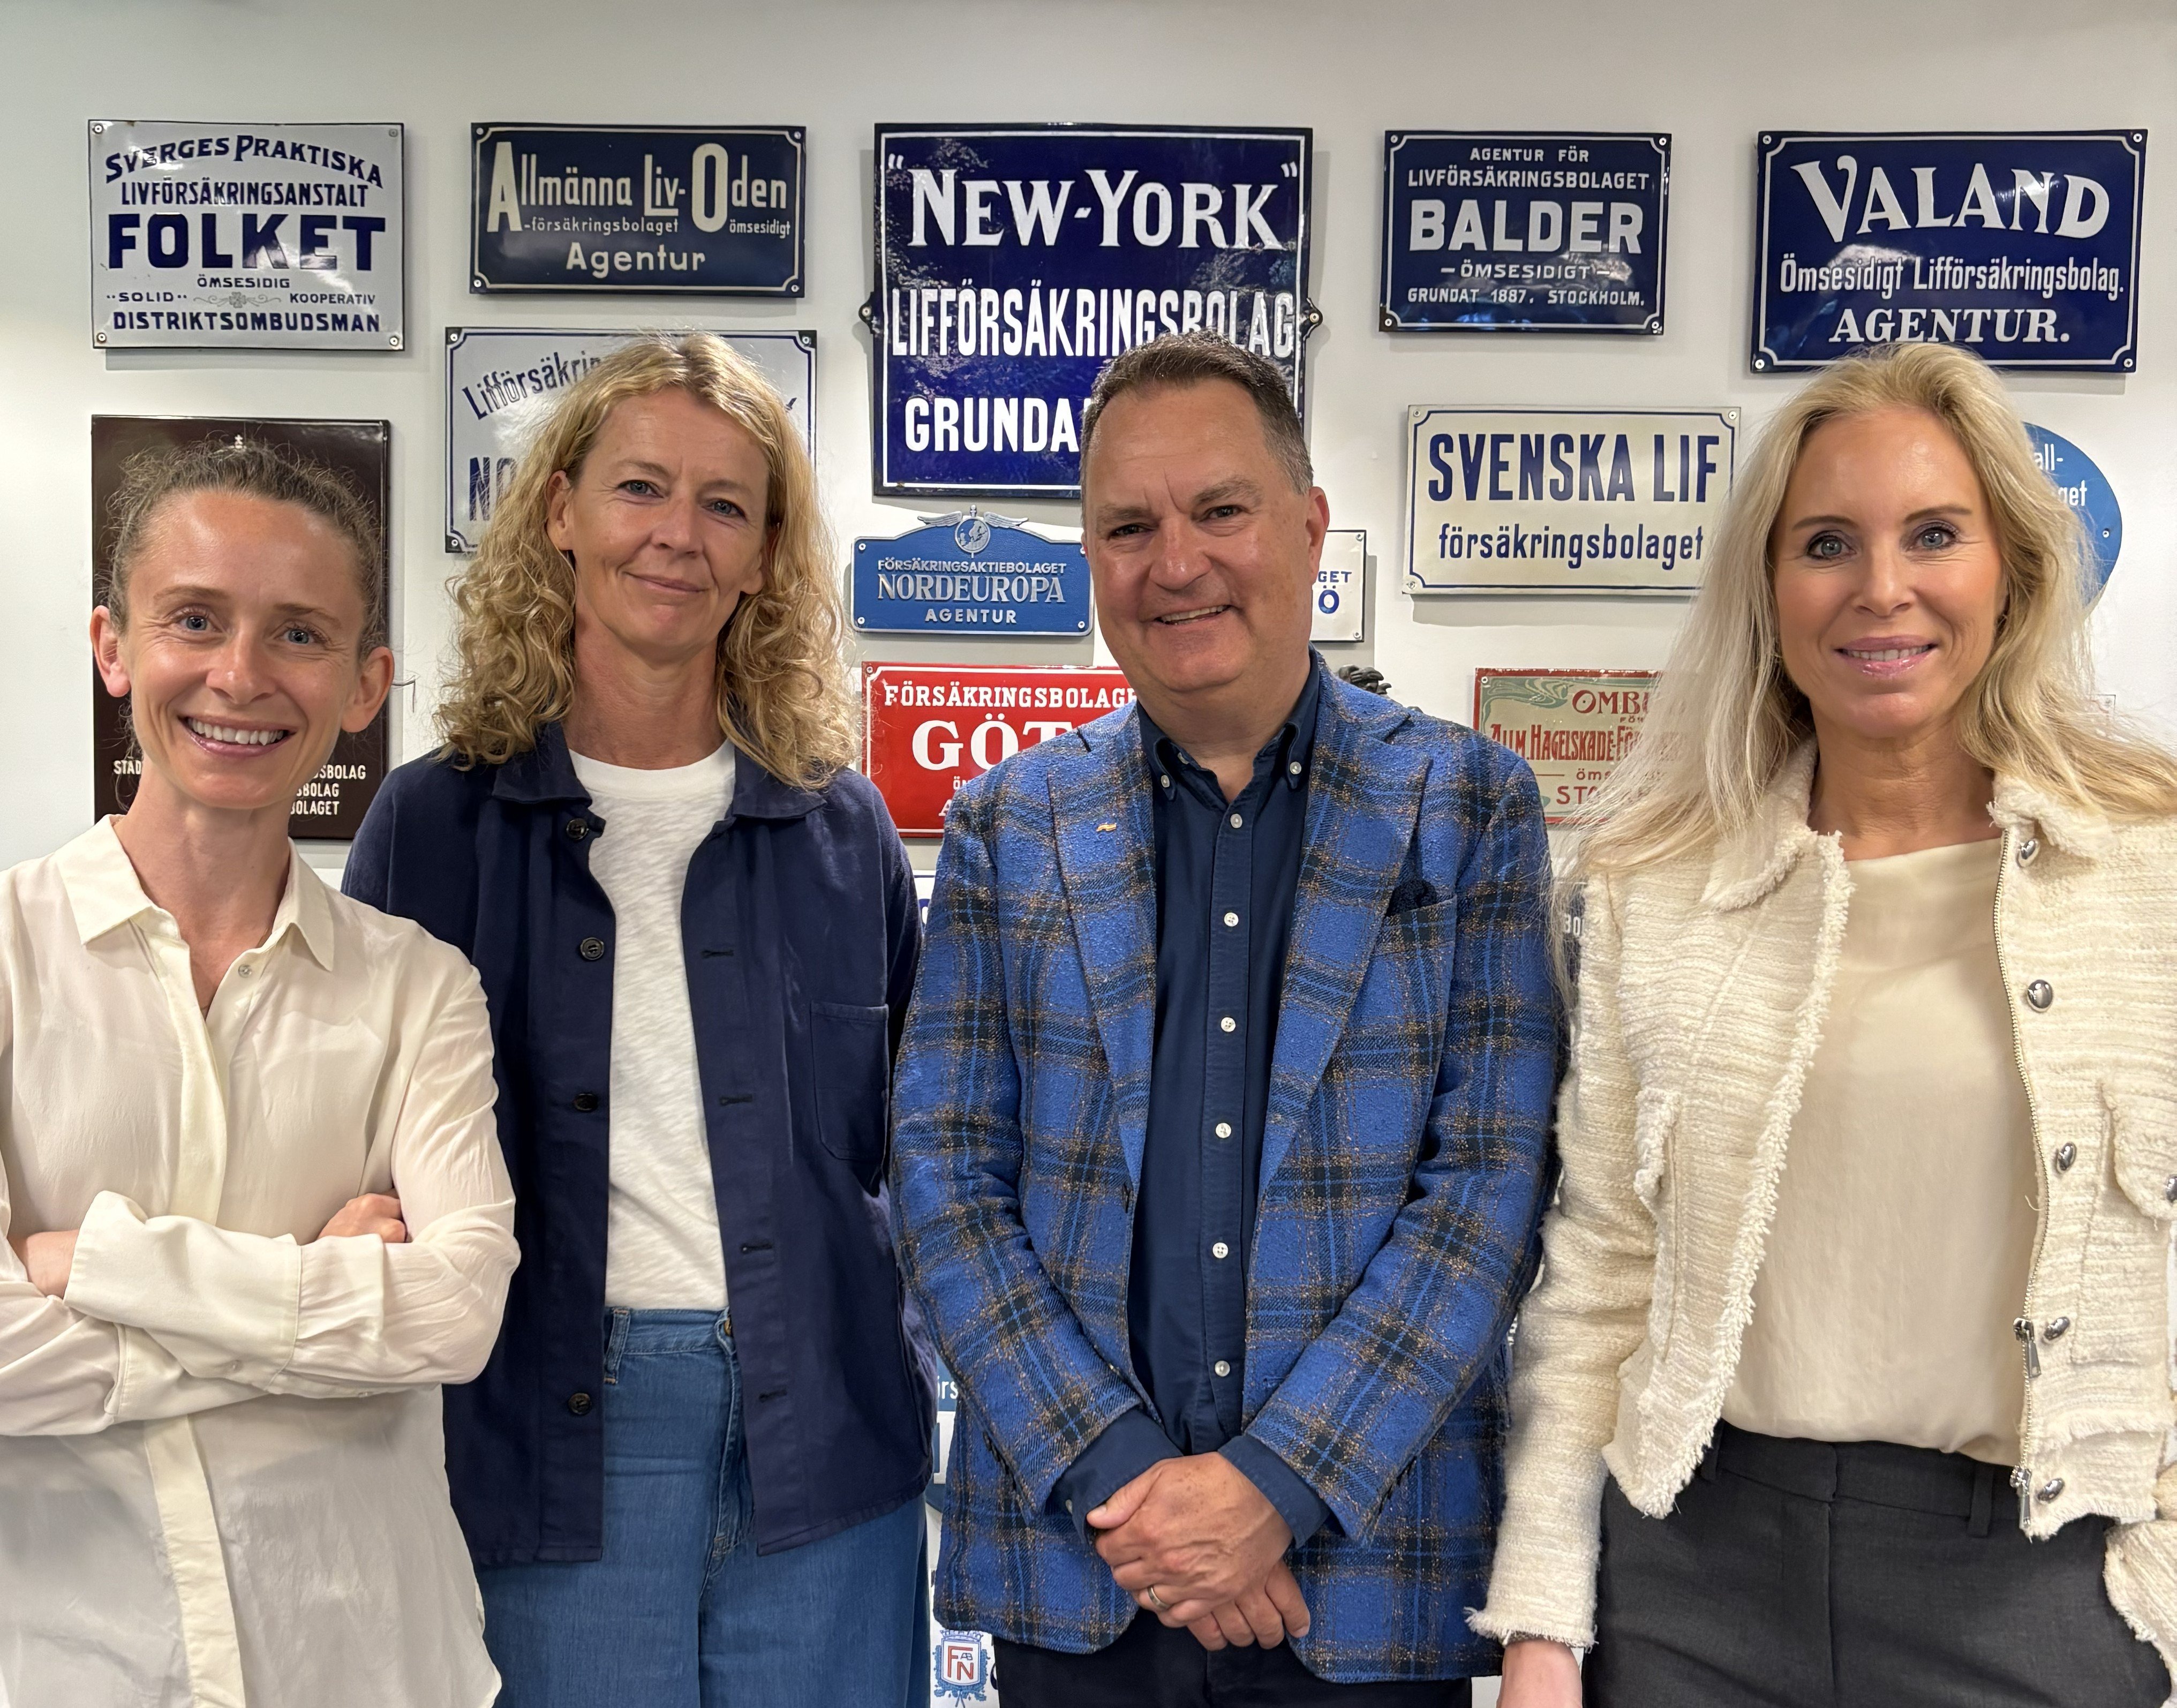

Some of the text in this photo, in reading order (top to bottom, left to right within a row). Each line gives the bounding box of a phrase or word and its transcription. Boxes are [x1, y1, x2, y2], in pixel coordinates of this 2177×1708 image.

[106, 135, 383, 189] SVERGES PRAKTISKA
[1470, 146, 1588, 162] AGENTUR FÖR
[122, 177, 369, 207] LIVFÖRSÄKRINGSANSTALT
[487, 141, 633, 232] Allmänna
[691, 143, 786, 232] Oden
[1408, 165, 1649, 190] LIVFÖRSÄKRINGSBOLAGET
[1790, 155, 2110, 243] VALAND
[729, 219, 790, 239] ömsesidigt
[1410, 199, 1643, 254] BALDER
[108, 213, 386, 271] FOLKET
[566, 242, 705, 279] Agentur
[1460, 260, 1590, 280] ÖMSESIDIGT
[197, 274, 290, 289] ÖMSESIDIG
[1780, 254, 2123, 301] Ömsesidigt Lifförsäkringsbolag.
[290, 293, 375, 304] KOOPERATIV
[1407, 288, 1645, 306] GRUNDAT 1887. STOCKHOLM.
[114, 312, 380, 332] DISTRIKTSOMBUDSMAN
[891, 278, 1294, 358] LIFFÖRSÄKRINGSBOLAG
[1828, 309, 2070, 343] AGENTUR.
[906, 397, 1091, 452] GRUNDA
[1428, 433, 1720, 502] SVENSKA LIF
[1438, 523, 1704, 570] försäkringsbolaget
[878, 556, 1067, 574] FÖRSÄKRINGSAKTIEBOLAGET
[877, 574, 1066, 604] NORDEUROPA
[925, 608, 1017, 623] AGENTUR
[314, 764, 366, 780] SBOLAG
